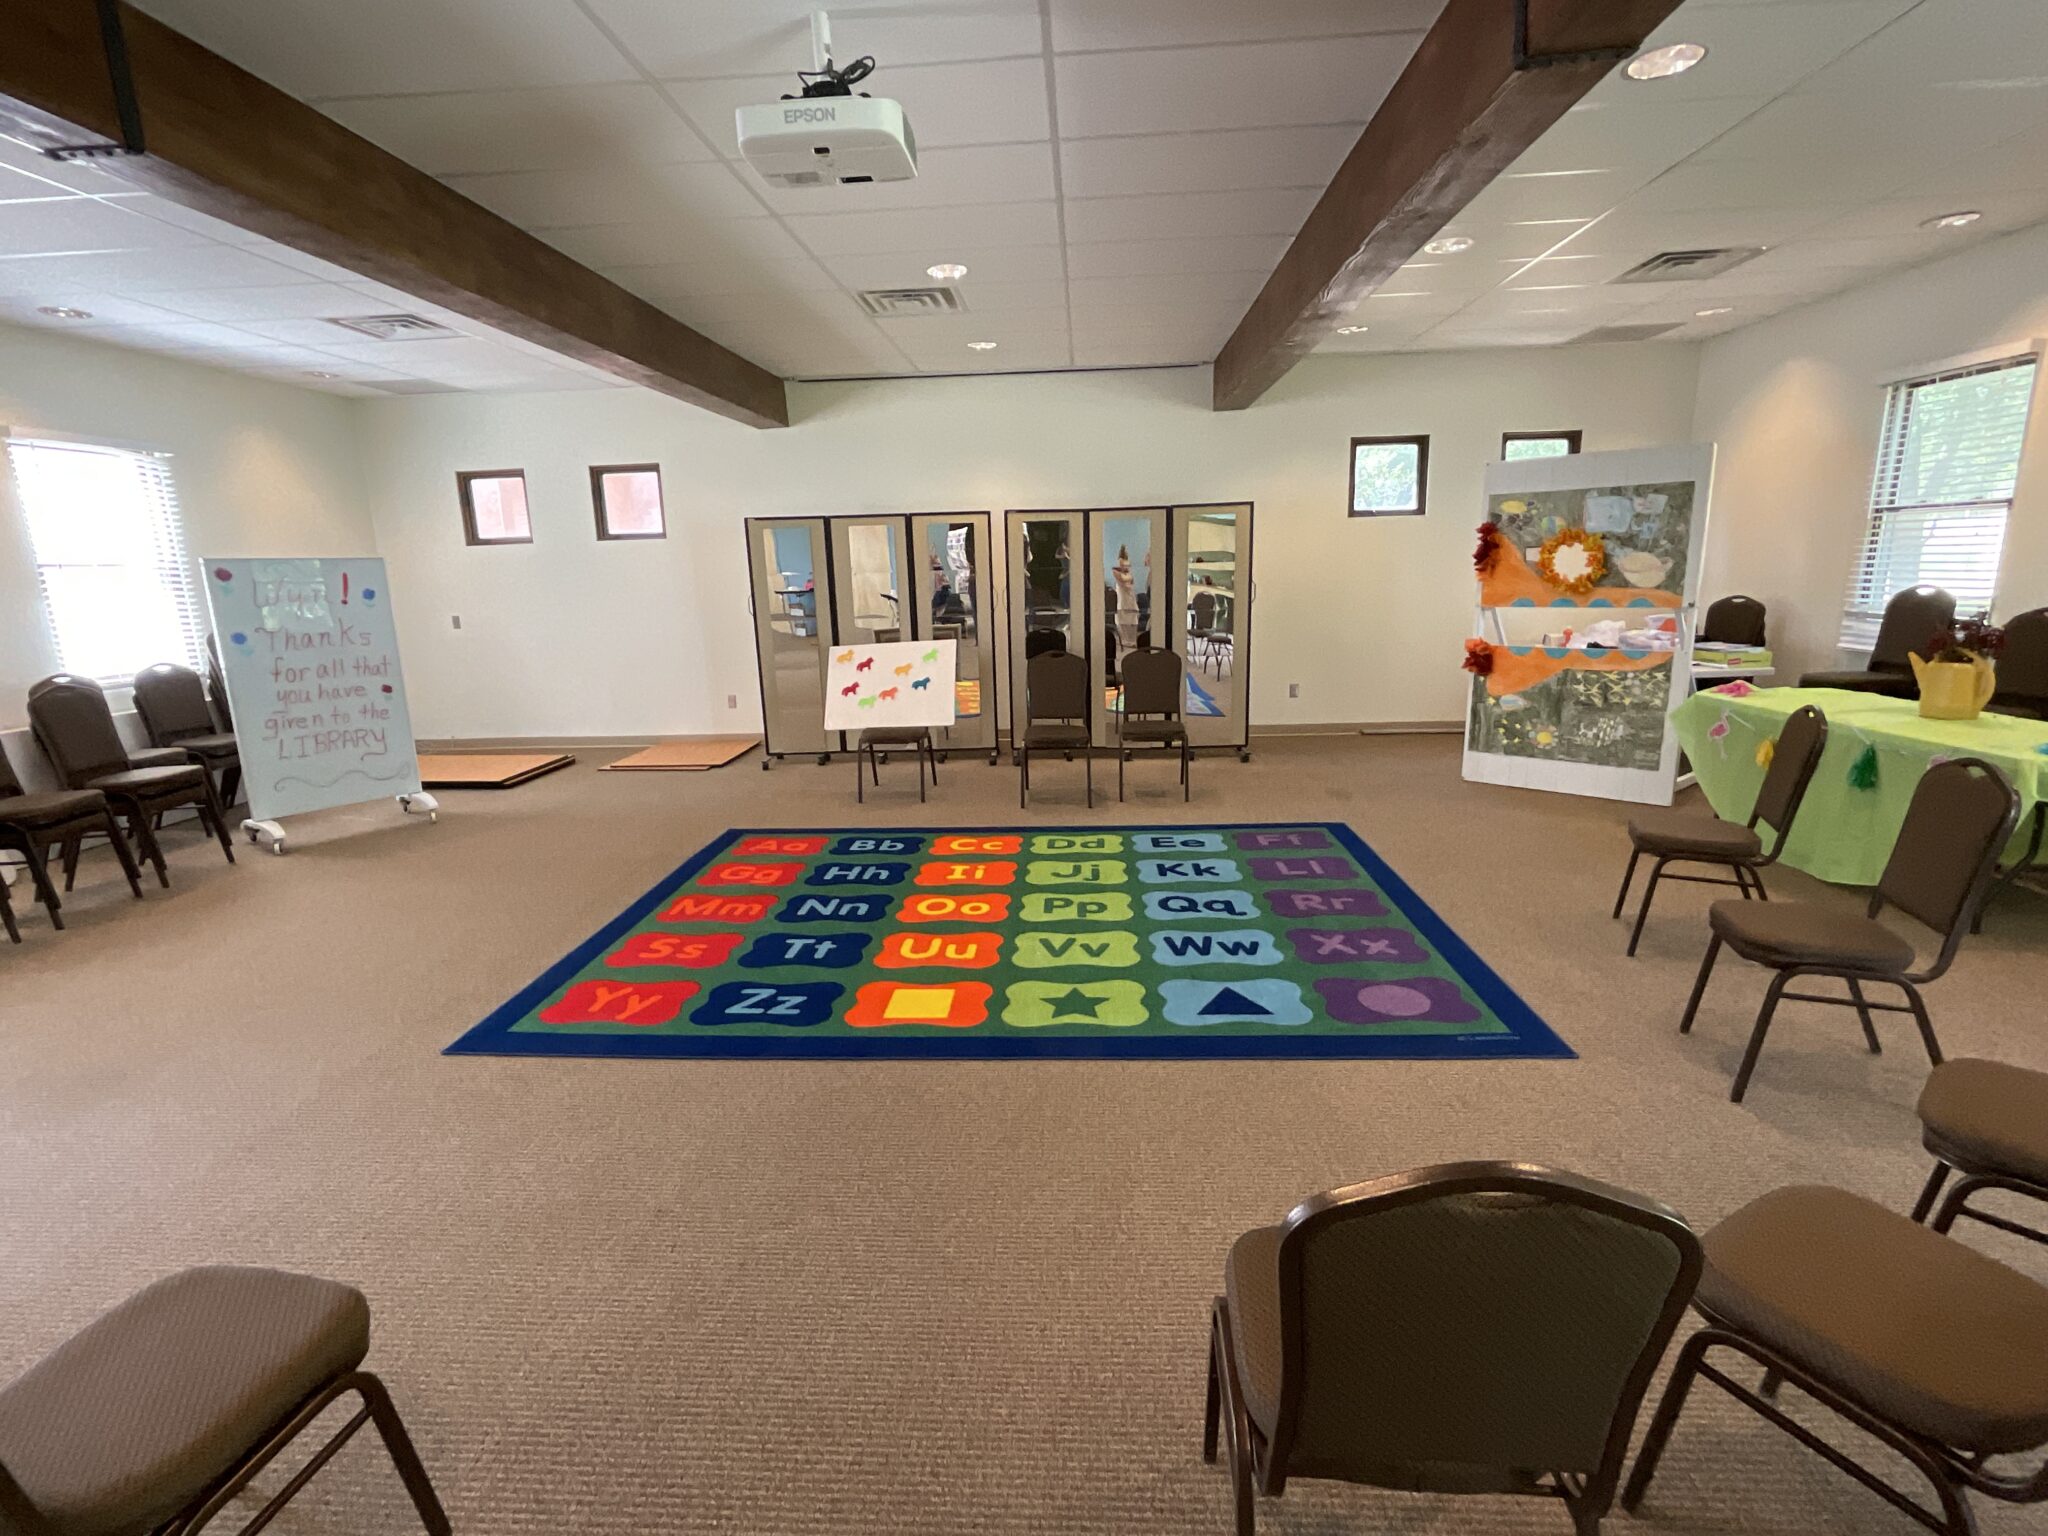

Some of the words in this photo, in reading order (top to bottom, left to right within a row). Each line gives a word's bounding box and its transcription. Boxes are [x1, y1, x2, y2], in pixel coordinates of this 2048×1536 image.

[784, 107, 835, 124] EPSON
[254, 618, 372, 651] Thanks
[271, 657, 310, 684] for
[316, 657, 345, 680] all
[352, 655, 391, 678] that
[276, 687, 312, 707] you
[318, 683, 368, 701] have
[264, 711, 324, 741] given
[330, 705, 350, 725] to
[358, 702, 390, 721] the
[278, 728, 389, 762] LIBRARY
[748, 838, 808, 853] Aa
[849, 838, 904, 852] Bb
[949, 838, 1003, 852] Cc
[1046, 836, 1106, 851] Dd
[1150, 836, 1206, 849] Ee
[1255, 833, 1303, 845] Ff
[719, 865, 783, 884] Gg
[823, 865, 890, 881] Hh
[946, 864, 986, 880] Ii
[1050, 863, 1101, 882] Jj
[1156, 863, 1220, 878] Kk
[1275, 860, 1325, 875] Ll
[669, 899, 763, 916] Mm
[796, 898, 869, 916] Nn
[916, 898, 990, 915] Oo
[1043, 897, 1108, 919] Pp
[1158, 896, 1247, 916] Qq
[1290, 893, 1354, 911] Rr
[639, 938, 707, 960] Ss
[784, 938, 836, 959] Tt
[900, 938, 977, 960] Uu
[1039, 937, 1110, 958] Vv
[1164, 935, 1260, 957] Ww
[1310, 933, 1398, 956] Xx
[590, 986, 663, 1020] Yy
[724, 988, 807, 1015] Zz
